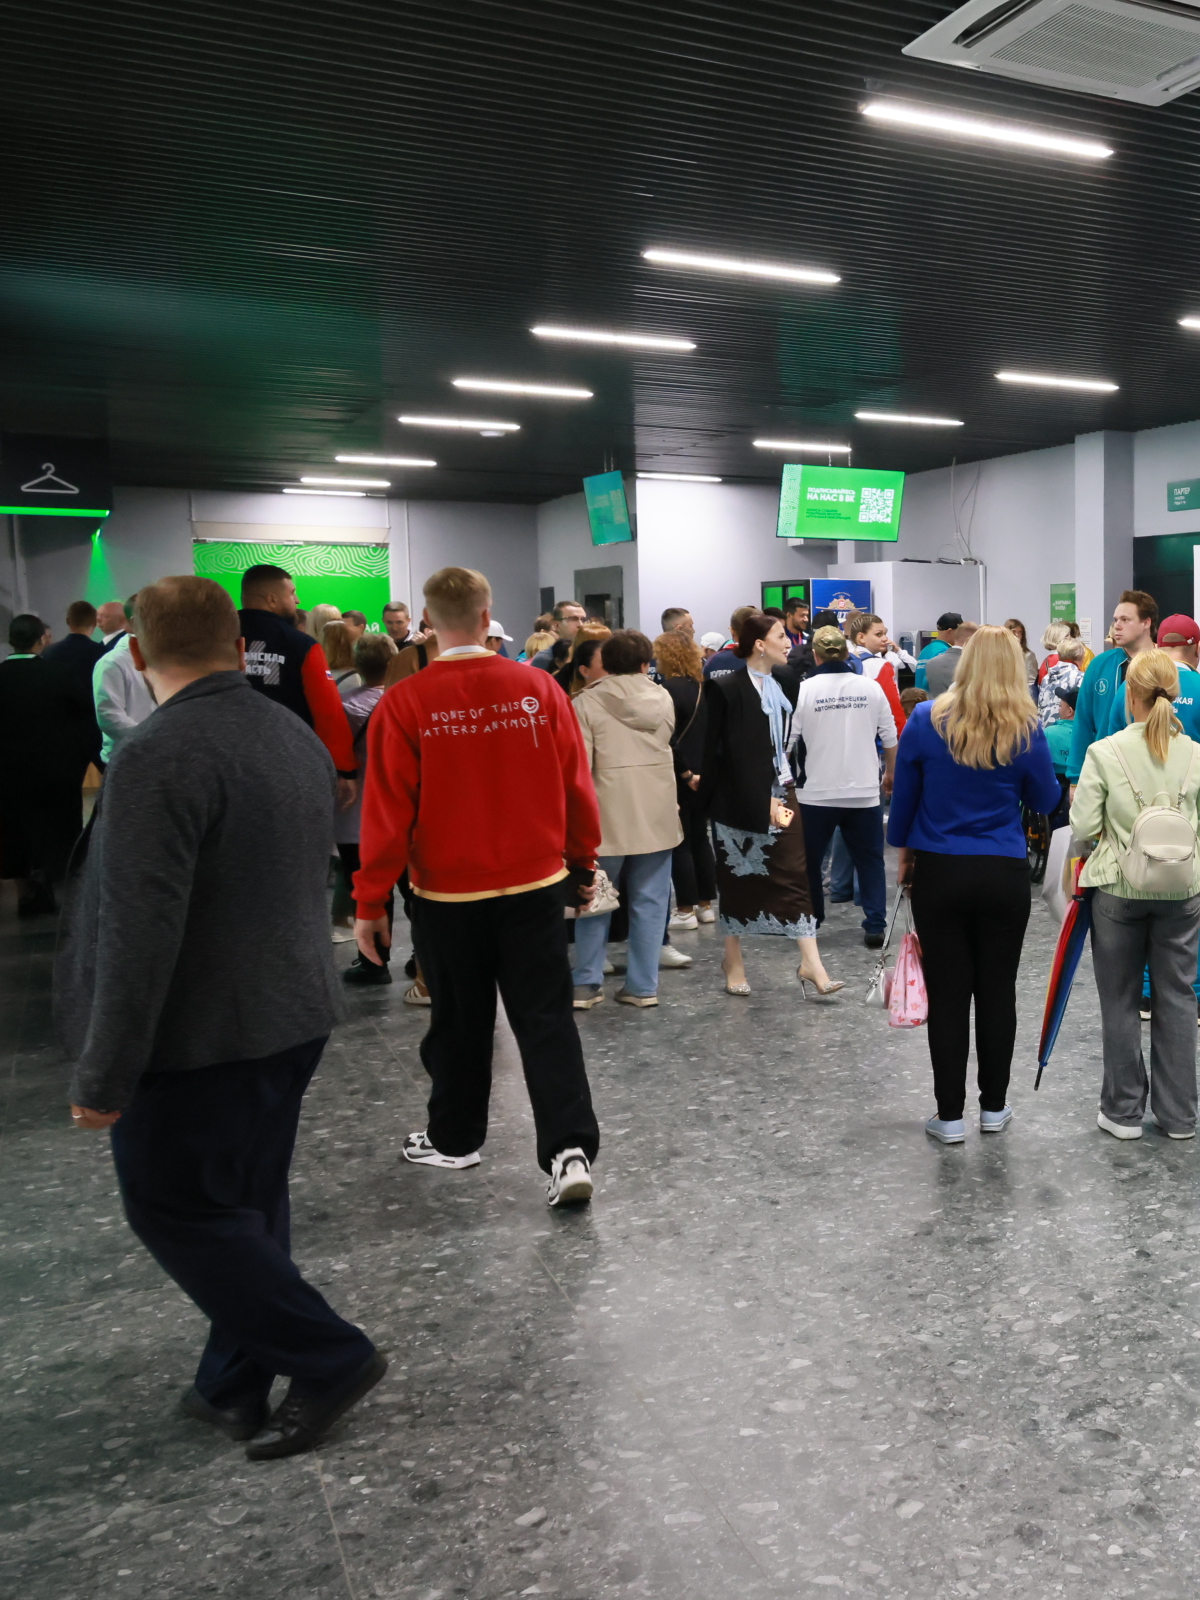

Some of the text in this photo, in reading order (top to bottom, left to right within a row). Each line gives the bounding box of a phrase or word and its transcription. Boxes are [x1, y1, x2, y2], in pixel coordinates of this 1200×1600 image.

[1173, 486, 1191, 496] ПАРТЕР
[806, 492, 856, 503] НА НАС В ВК
[244, 651, 286, 665] ИНСКАЯ
[245, 664, 272, 676] АСТЬ
[816, 695, 867, 704] ЯМАЛО-НЕНЕЦКИЙ
[814, 702, 852, 713] АВТОНОМНЫЙ
[431, 709, 466, 722] NONE
[469, 707, 485, 720] OF
[419, 715, 548, 737] ATTERS ANYMORE
